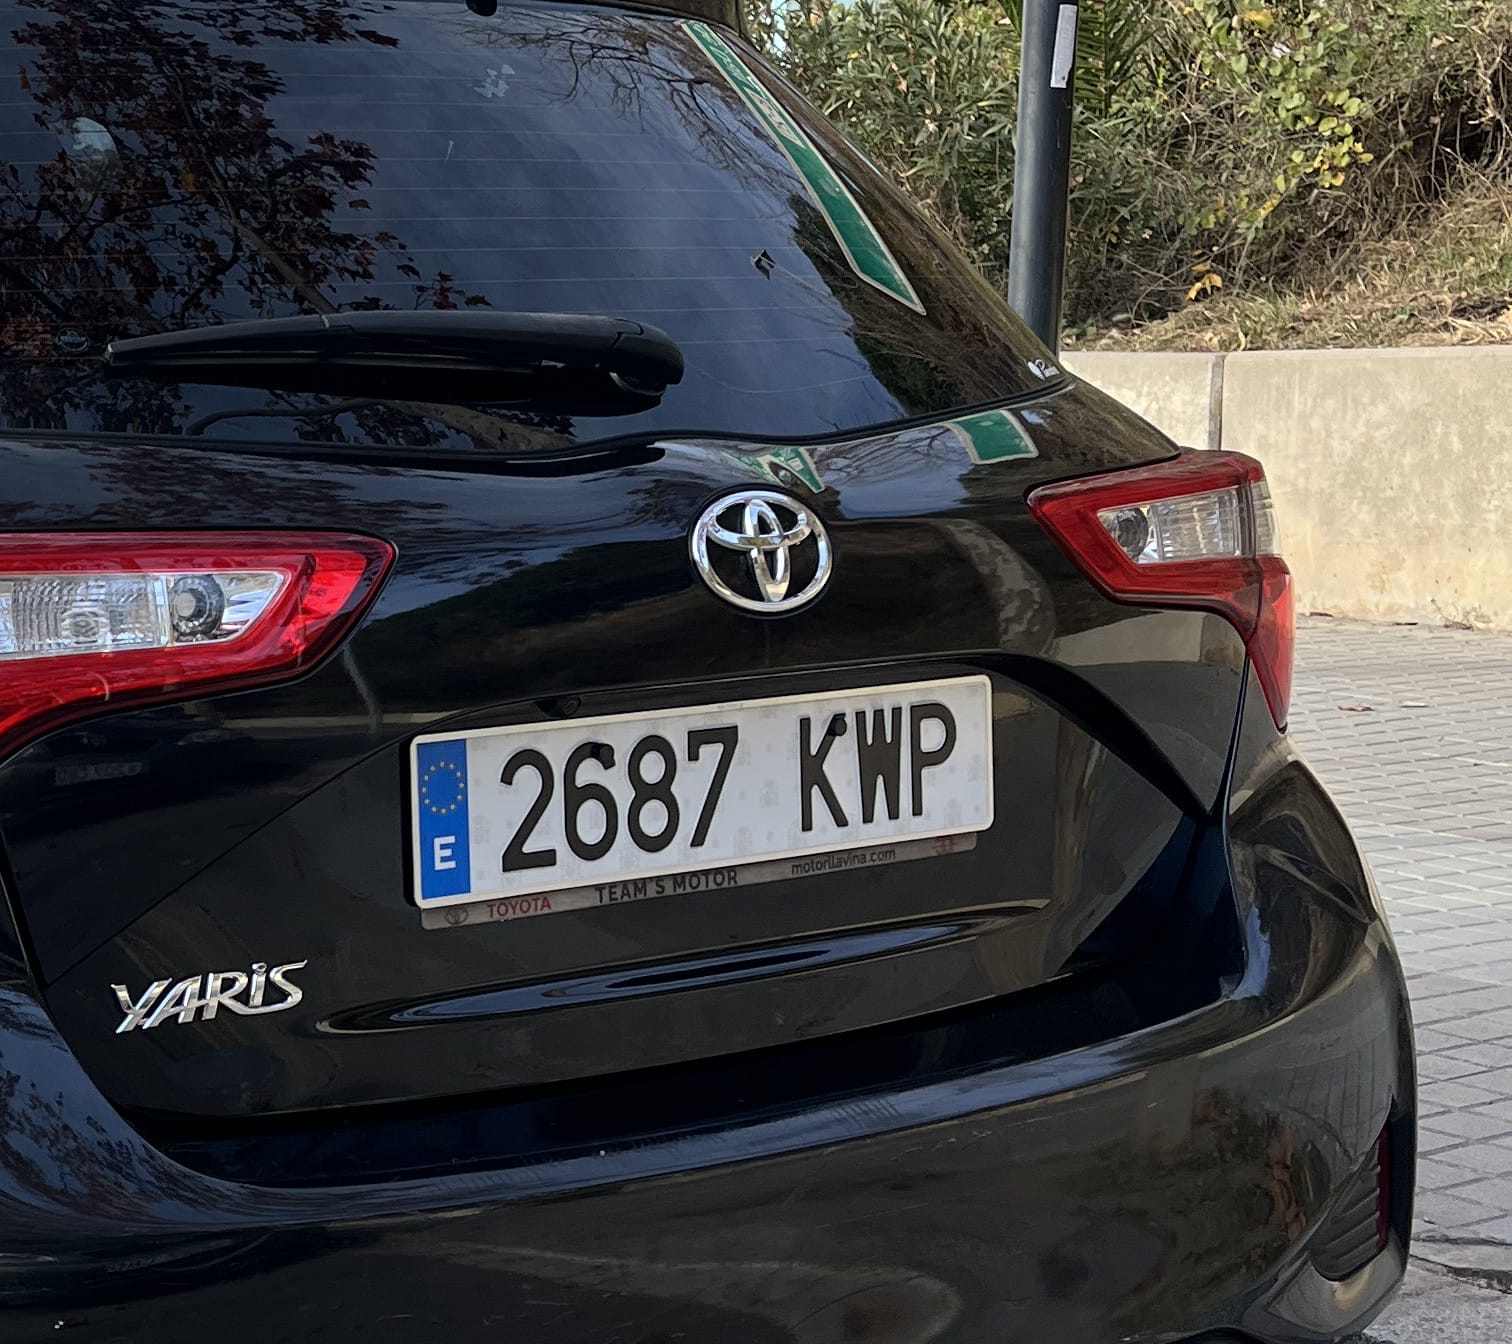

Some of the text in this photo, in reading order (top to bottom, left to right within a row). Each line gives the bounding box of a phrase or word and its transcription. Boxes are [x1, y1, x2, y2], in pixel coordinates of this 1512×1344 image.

[500, 702, 958, 872] 2687 KWP
[433, 834, 457, 871] E
[488, 896, 552, 920] TOYOTA
[672, 868, 738, 894] MOTOR
